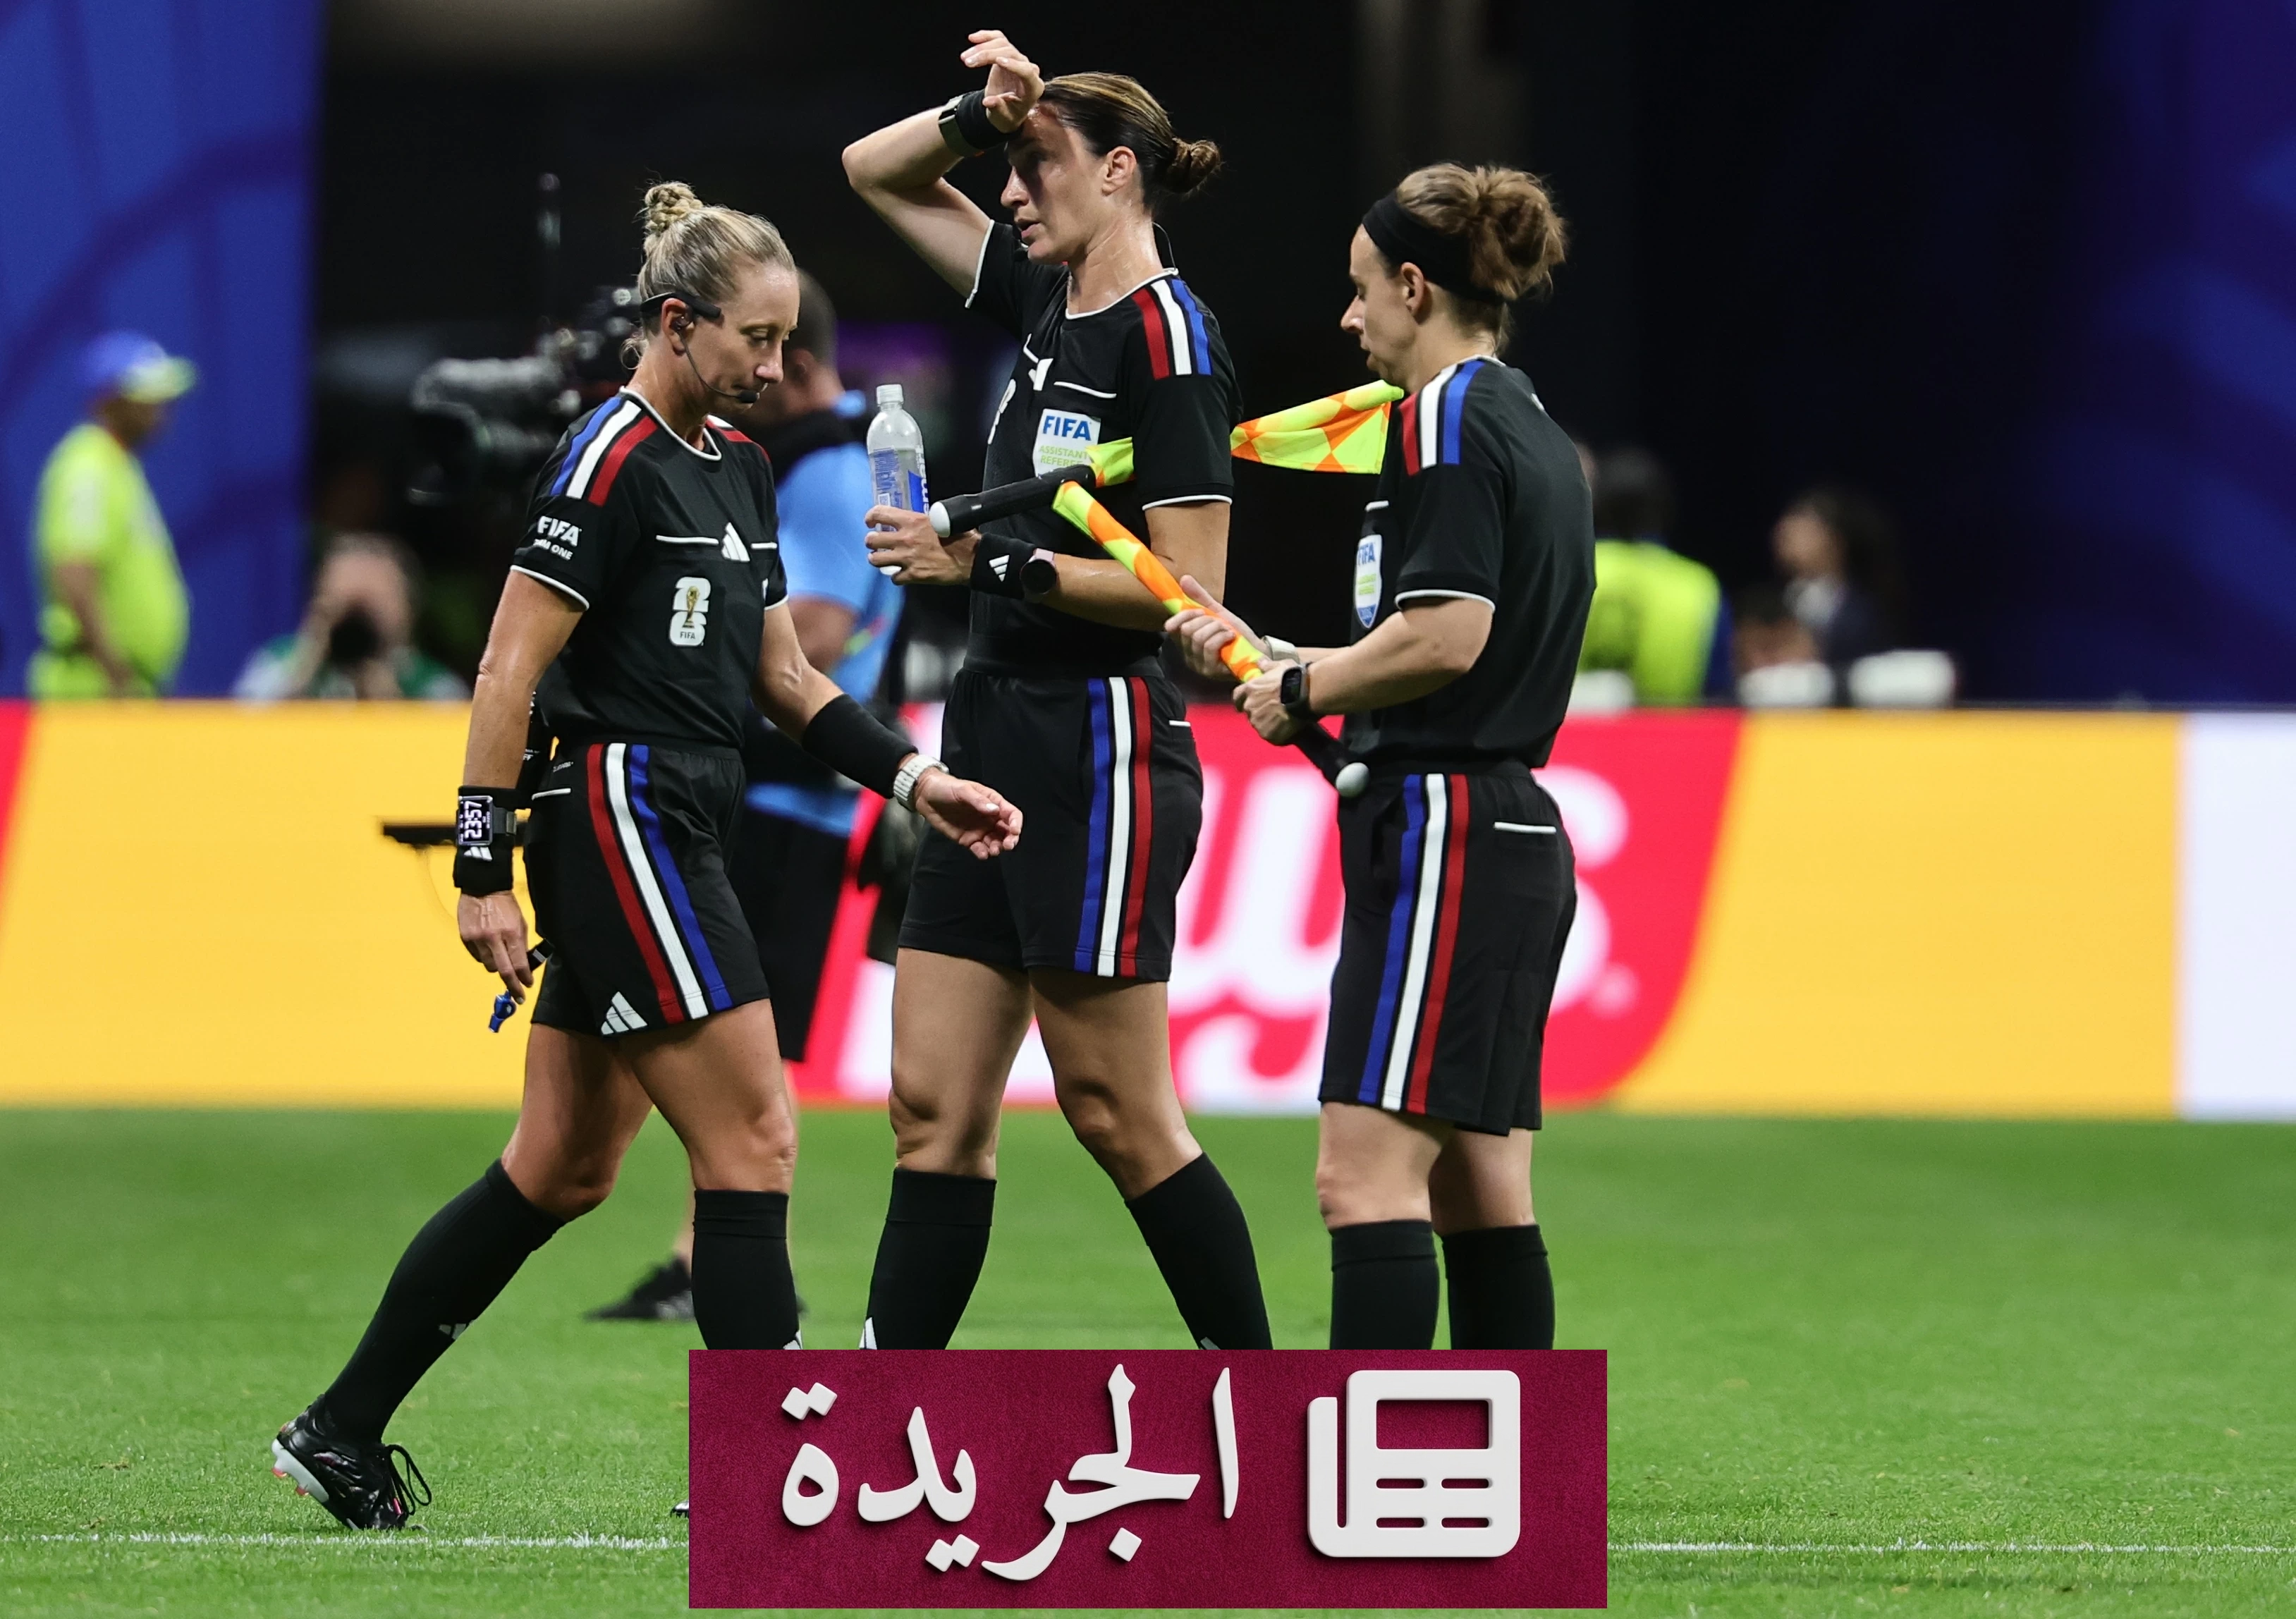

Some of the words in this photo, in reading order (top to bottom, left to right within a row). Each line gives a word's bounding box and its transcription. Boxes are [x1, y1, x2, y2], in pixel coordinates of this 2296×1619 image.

[1042, 415, 1092, 441] FIFA
[1039, 445, 1088, 459] ASSISTANT
[1040, 455, 1084, 467] REFERE
[537, 515, 580, 546] FIFA
[551, 544, 573, 561] ONE
[680, 631, 696, 640] FIFA
[464, 800, 482, 839] 23:57
